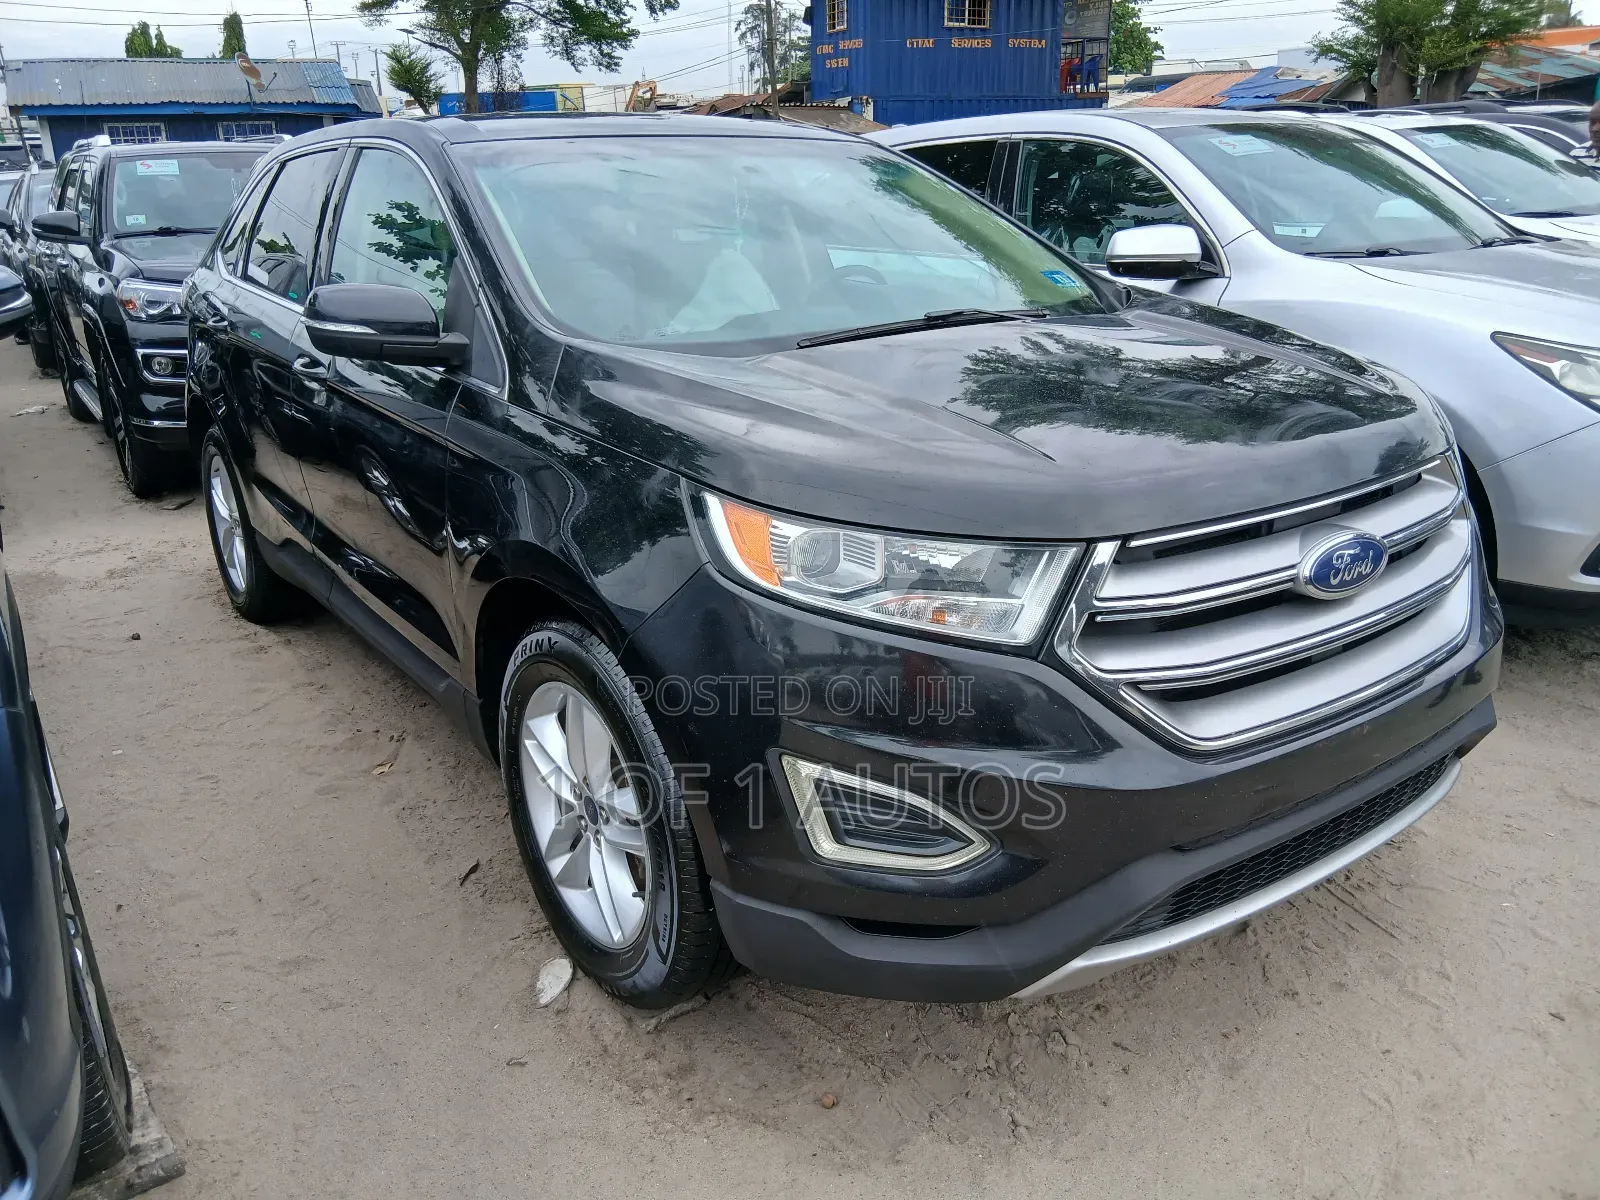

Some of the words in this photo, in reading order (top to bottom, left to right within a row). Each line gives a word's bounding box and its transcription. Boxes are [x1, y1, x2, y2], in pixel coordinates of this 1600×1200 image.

[951, 38, 992, 48] SERVICES
[1008, 38, 1047, 49] SYSTEM
[1329, 546, 1374, 585] Ford
